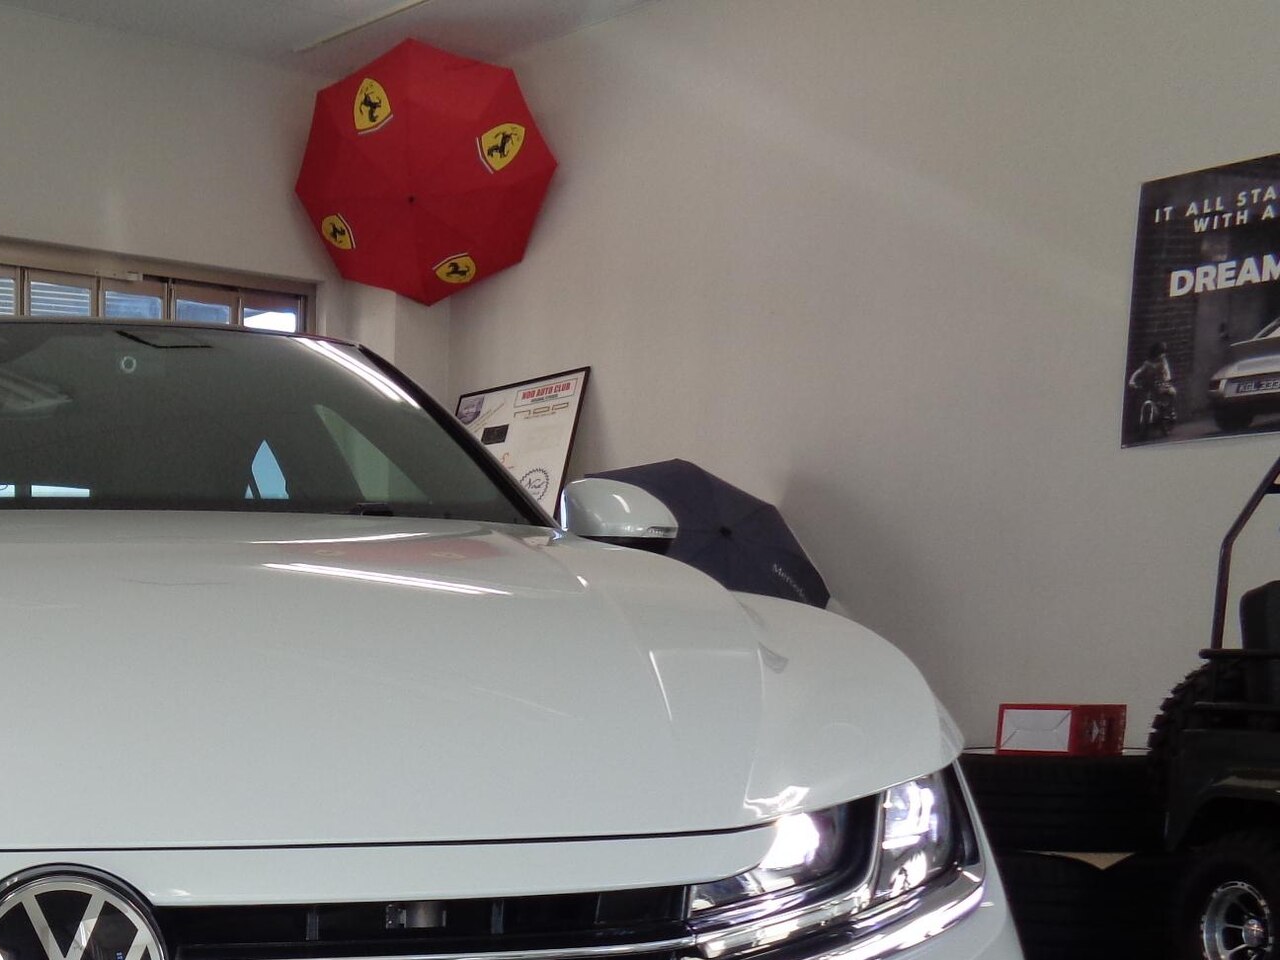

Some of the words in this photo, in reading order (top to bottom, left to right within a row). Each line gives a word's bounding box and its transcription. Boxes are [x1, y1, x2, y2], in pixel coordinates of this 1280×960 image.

[1154, 206, 1174, 224] IT
[1185, 197, 1225, 218] ALL
[1236, 185, 1277, 207] STA
[1193, 208, 1249, 233] WITH
[1261, 205, 1275, 221] A
[1169, 254, 1280, 297] DREAM
[536, 386, 554, 397] AUTO
[554, 382, 571, 393] CLUB
